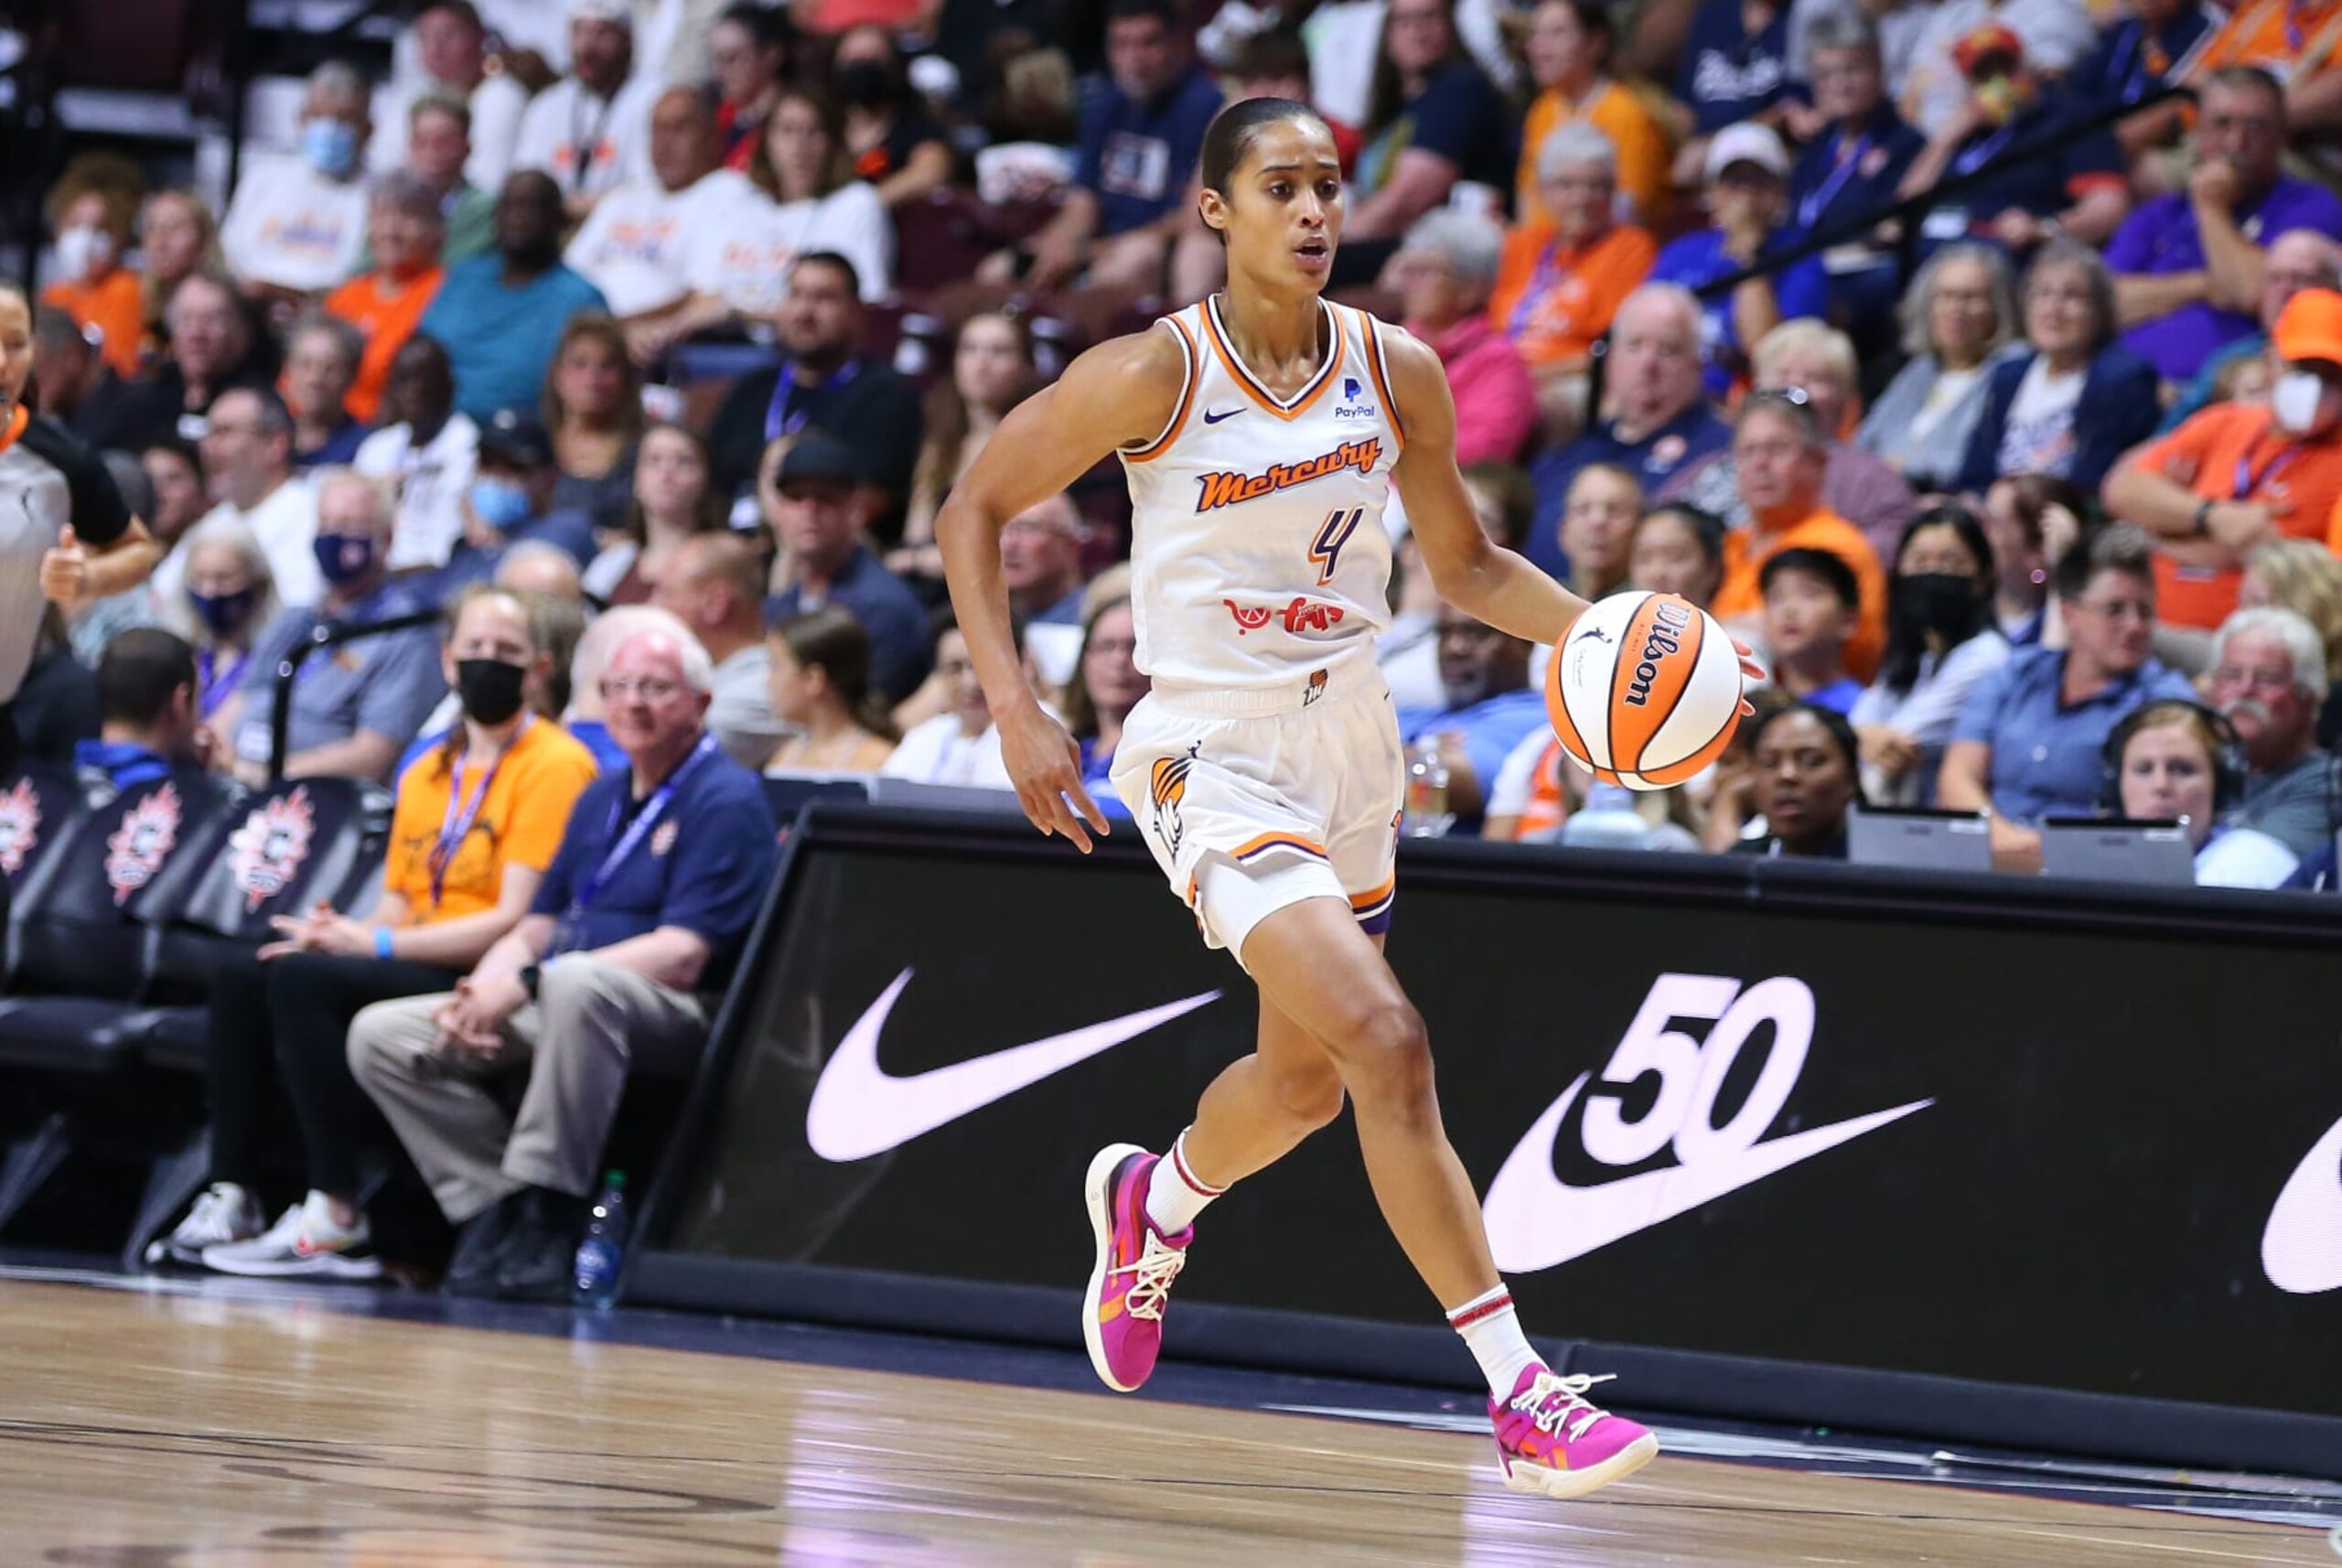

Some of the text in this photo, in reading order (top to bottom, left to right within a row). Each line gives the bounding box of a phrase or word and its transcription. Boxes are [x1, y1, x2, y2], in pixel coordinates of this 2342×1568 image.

[1335, 405, 1375, 418] PayPal
[1196, 437, 1382, 512] Mercury
[1308, 507, 1364, 585] 4
[1625, 602, 1691, 706] Wilson
[1581, 972, 1816, 1165] 50
